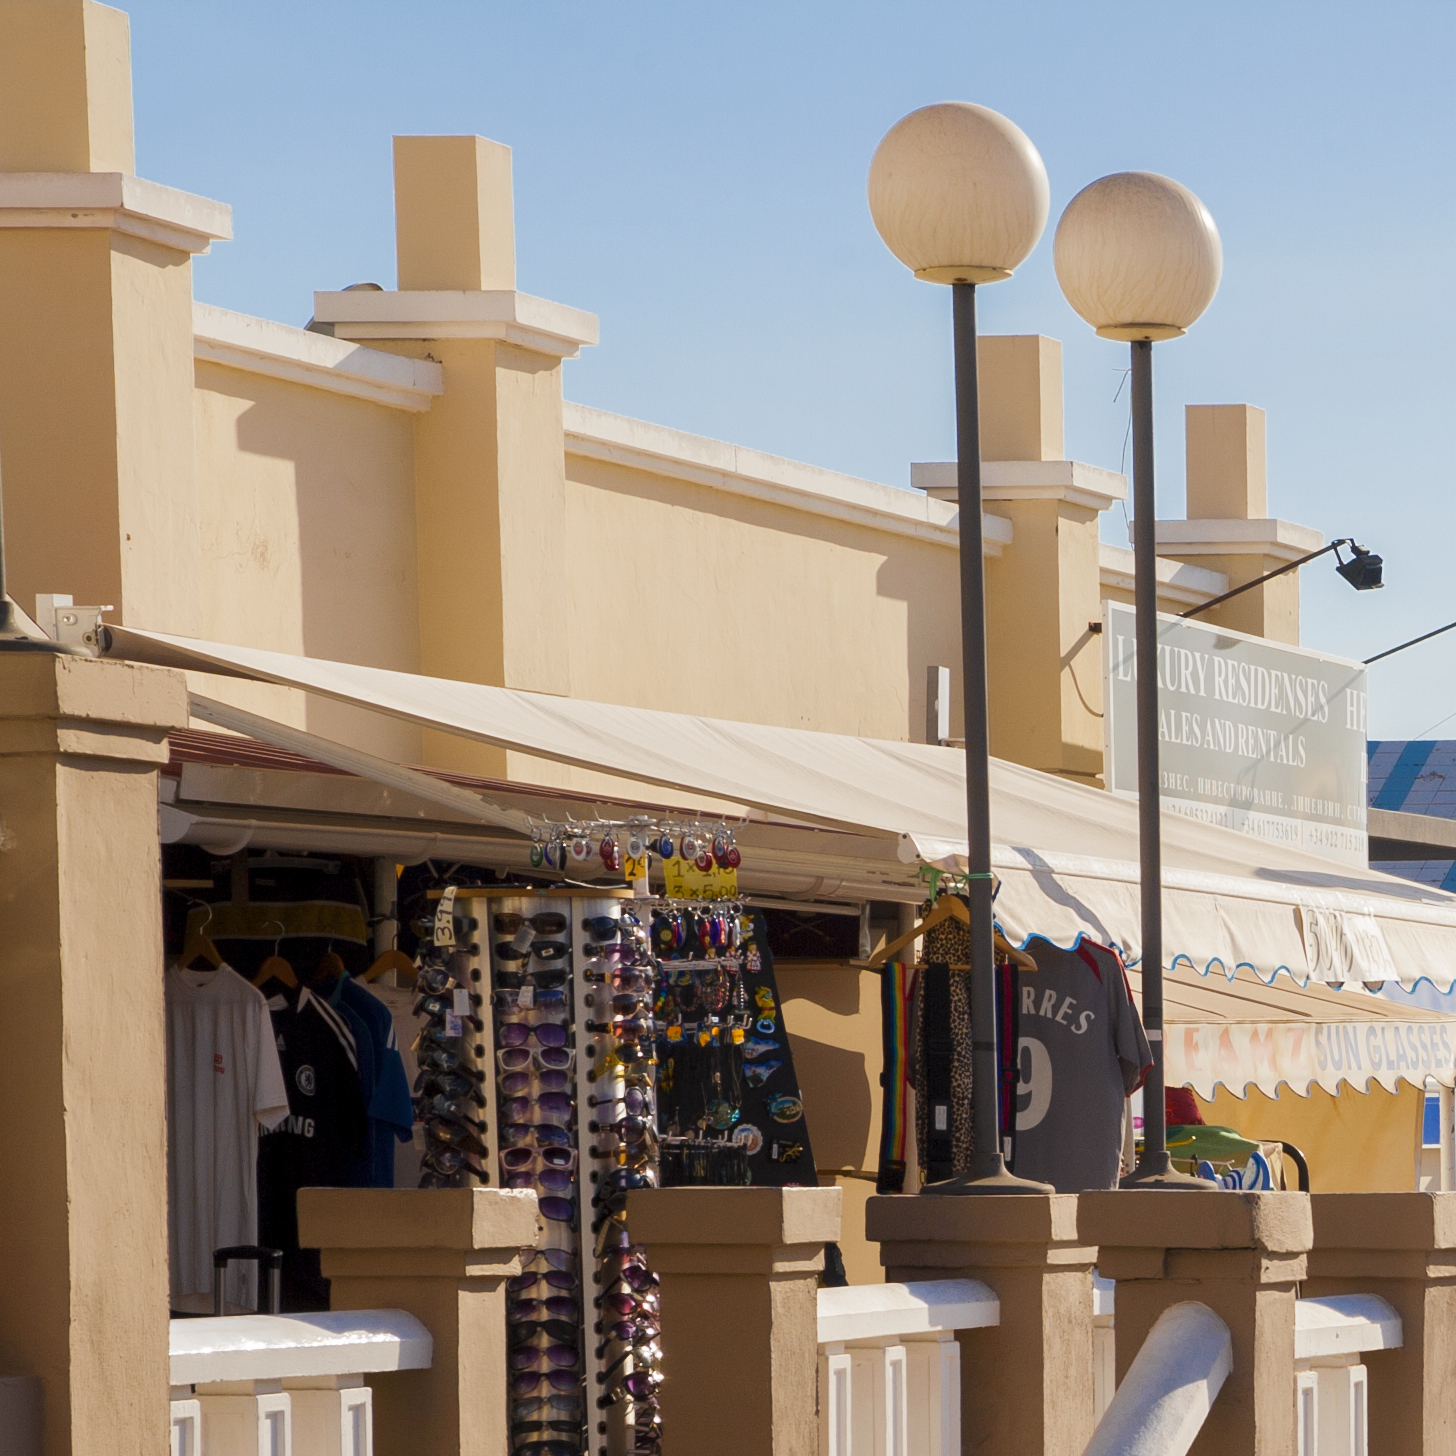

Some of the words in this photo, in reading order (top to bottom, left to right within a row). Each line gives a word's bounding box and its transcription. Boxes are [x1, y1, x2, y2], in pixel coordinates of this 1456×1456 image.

[1116, 634, 1209, 697] LXURY
[1213, 656, 1329, 724] RESIDENSES
[1158, 708, 1201, 748] ALES
[1203, 717, 1235, 754] AND
[1237, 722, 1306, 768] RENTALS
[1016, 1036, 1053, 1131] 9
[1313, 1024, 1359, 1072] SUN
[1364, 1024, 1452, 1072] GLASSES
